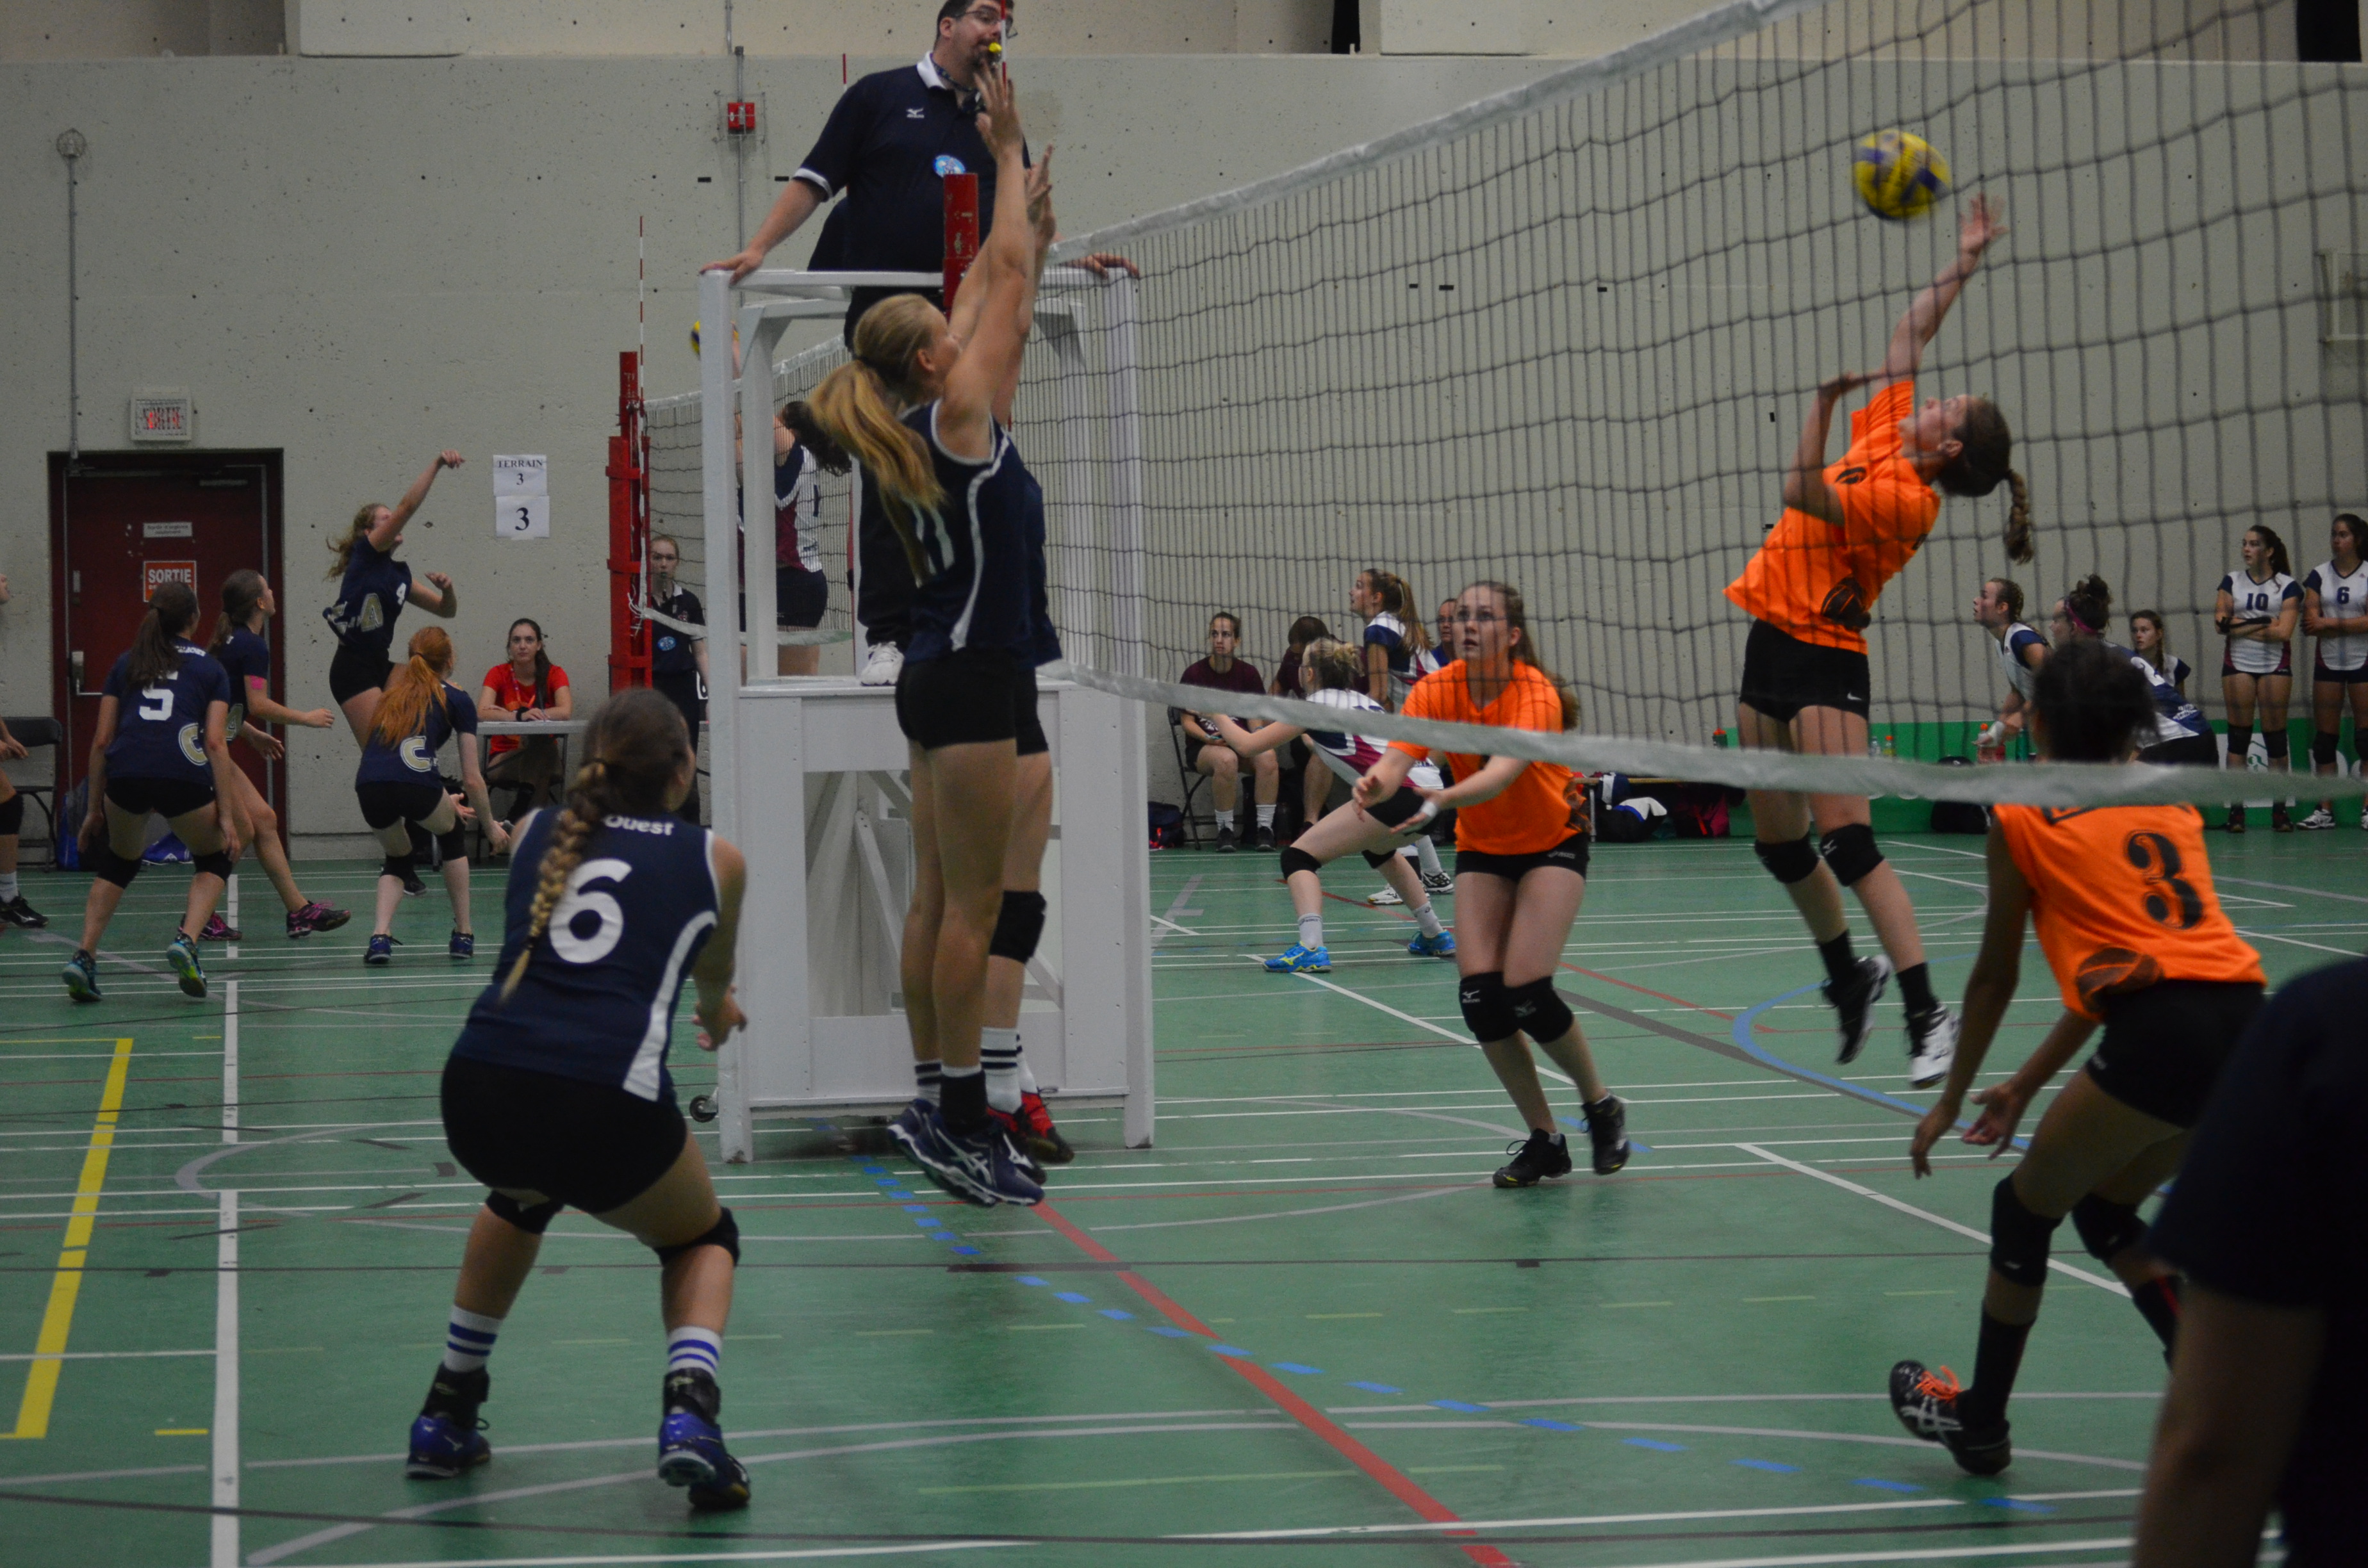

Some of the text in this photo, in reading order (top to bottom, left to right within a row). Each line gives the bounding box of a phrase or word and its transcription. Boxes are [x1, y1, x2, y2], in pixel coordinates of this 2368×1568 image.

[516, 473, 524, 486] 3
[515, 507, 529, 531] 3
[148, 568, 192, 584] SORTIE
[2246, 592, 2269, 611] 10
[2337, 586, 2350, 604] 6
[139, 671, 179, 721] 5
[2125, 829, 2207, 931] 3
[548, 858, 632, 964] 6
